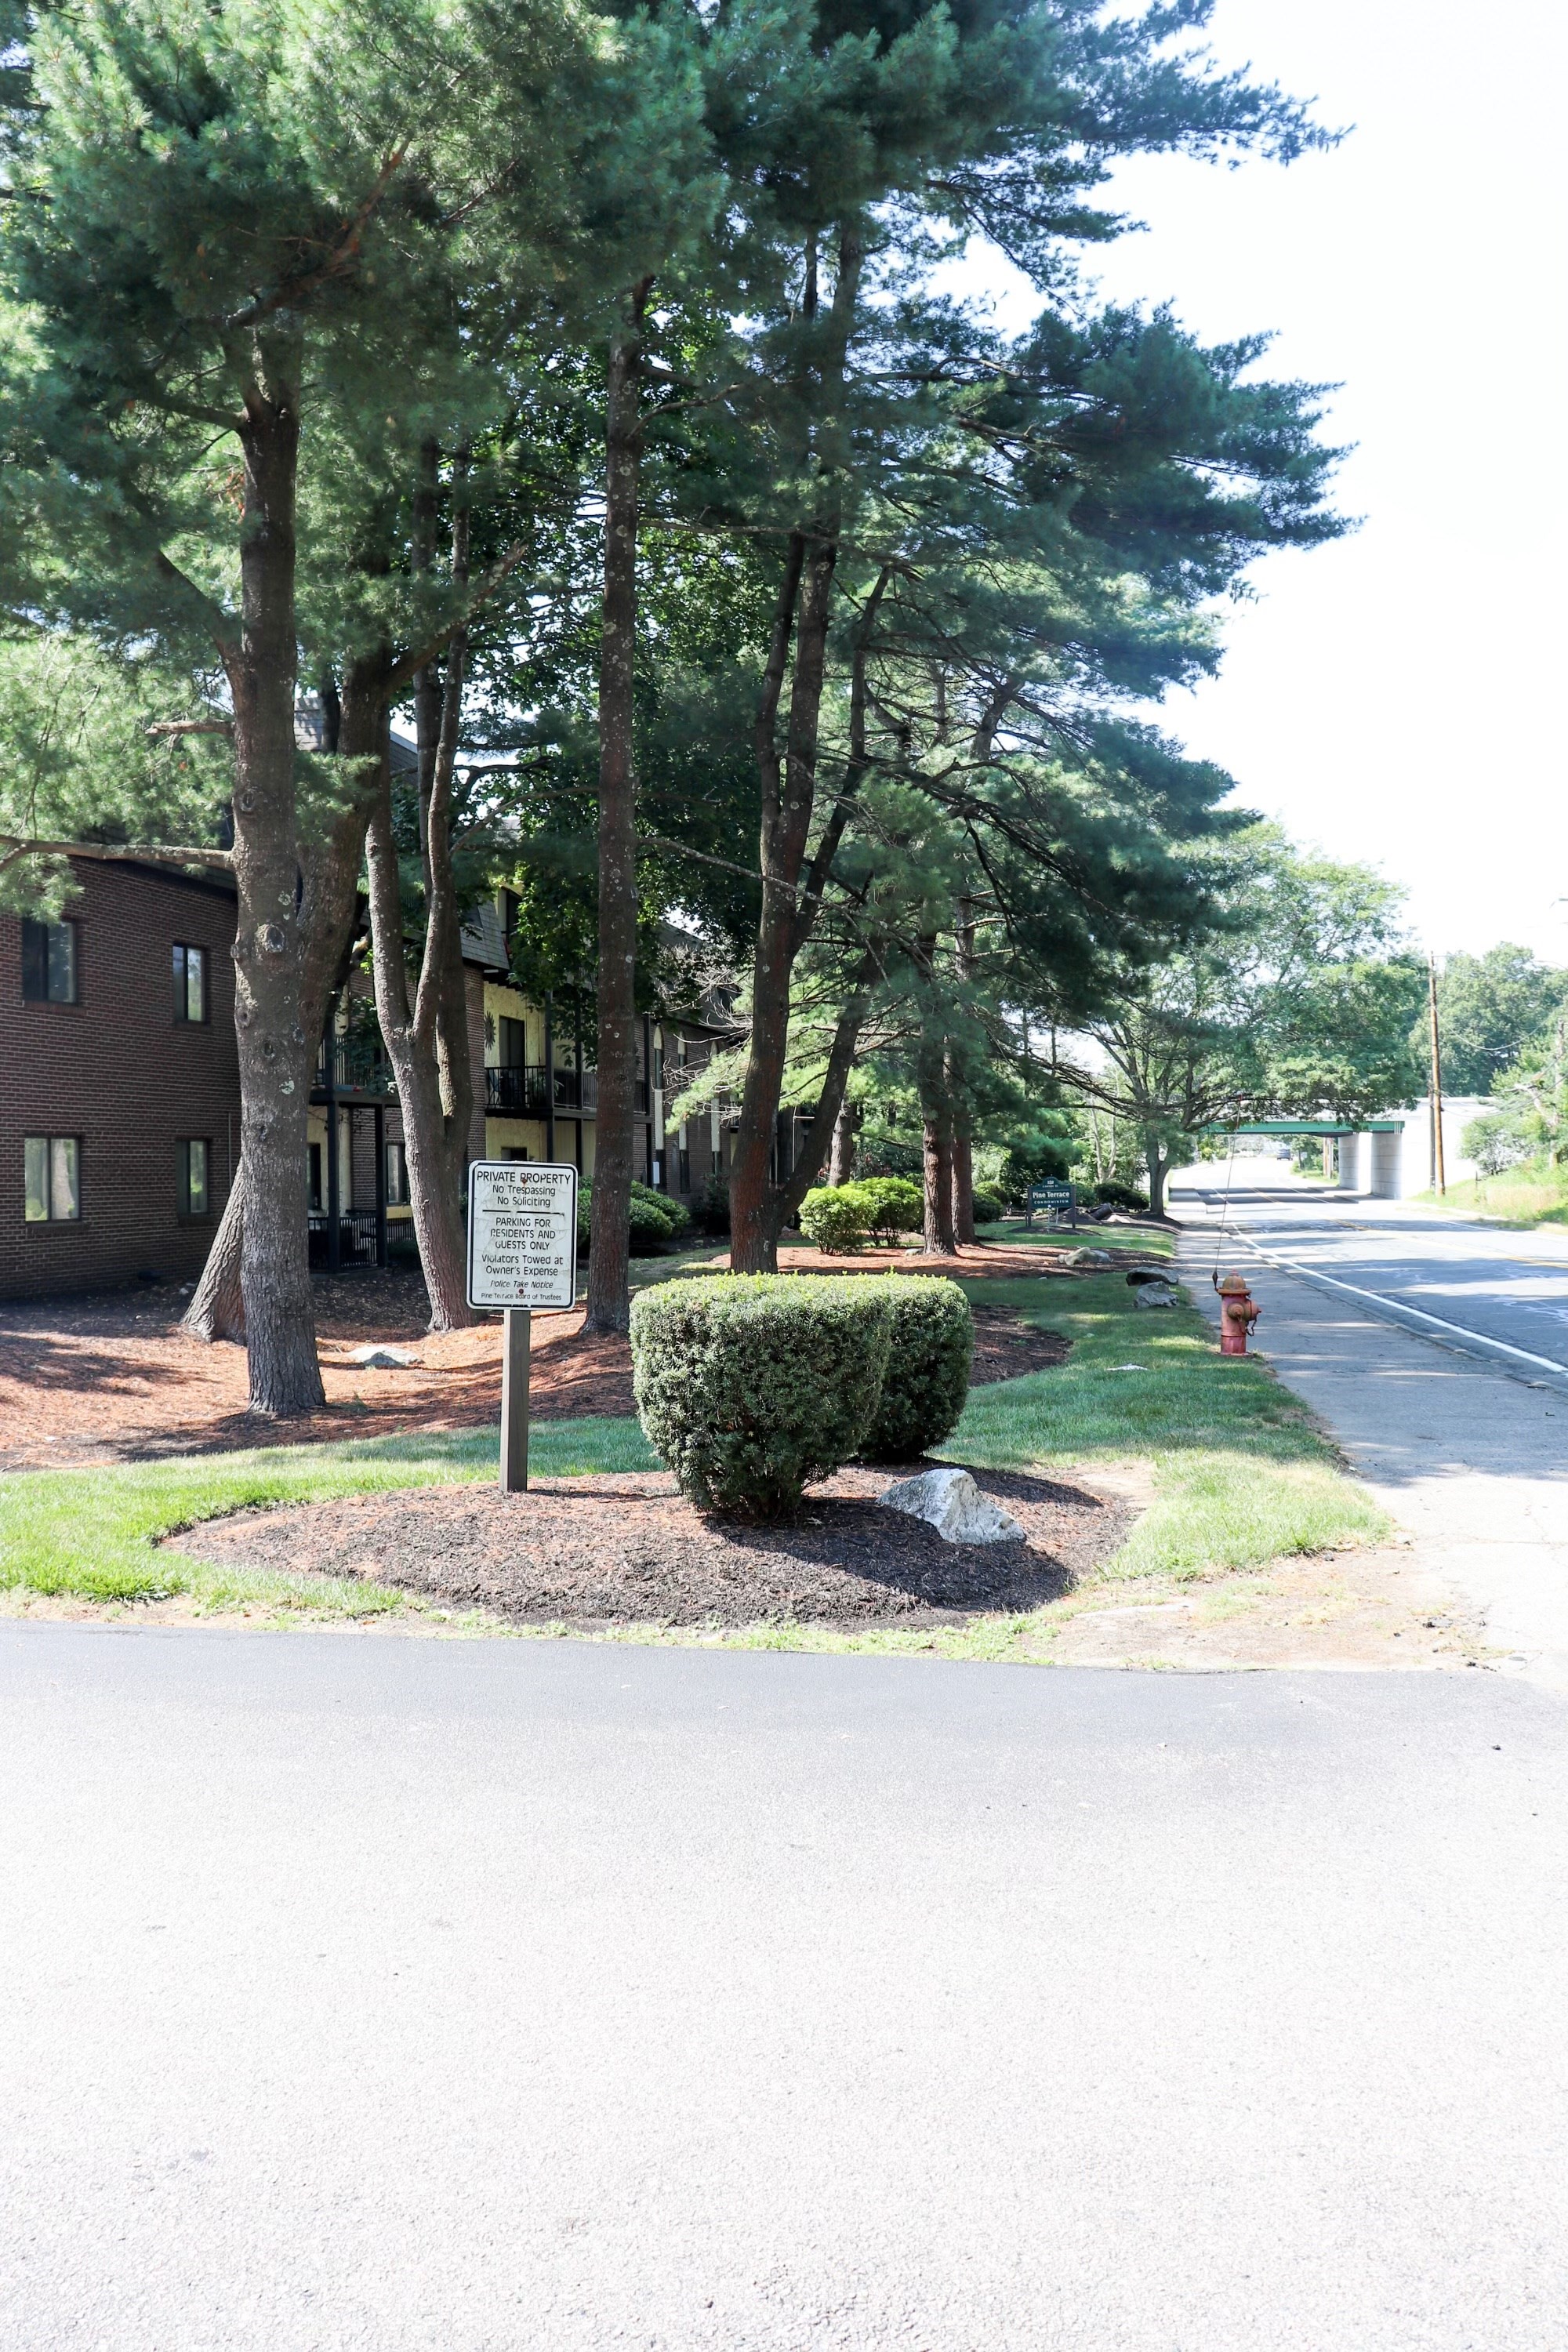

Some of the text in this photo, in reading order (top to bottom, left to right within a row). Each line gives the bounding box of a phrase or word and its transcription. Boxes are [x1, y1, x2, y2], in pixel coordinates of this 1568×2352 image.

[477, 1171, 571, 1185] PRIVATE PROPERTY
[493, 1185, 555, 1196] No Trespassing
[513, 1197, 550, 1207] Soliciting
[496, 1218, 531, 1226] PARKING
[491, 1229, 555, 1239] RESIDENTS AND
[495, 1240, 525, 1250] GUESTS
[482, 1254, 519, 1263] Violators
[522, 1255, 550, 1265] Towed
[486, 1265, 558, 1276] Owner's Expense
